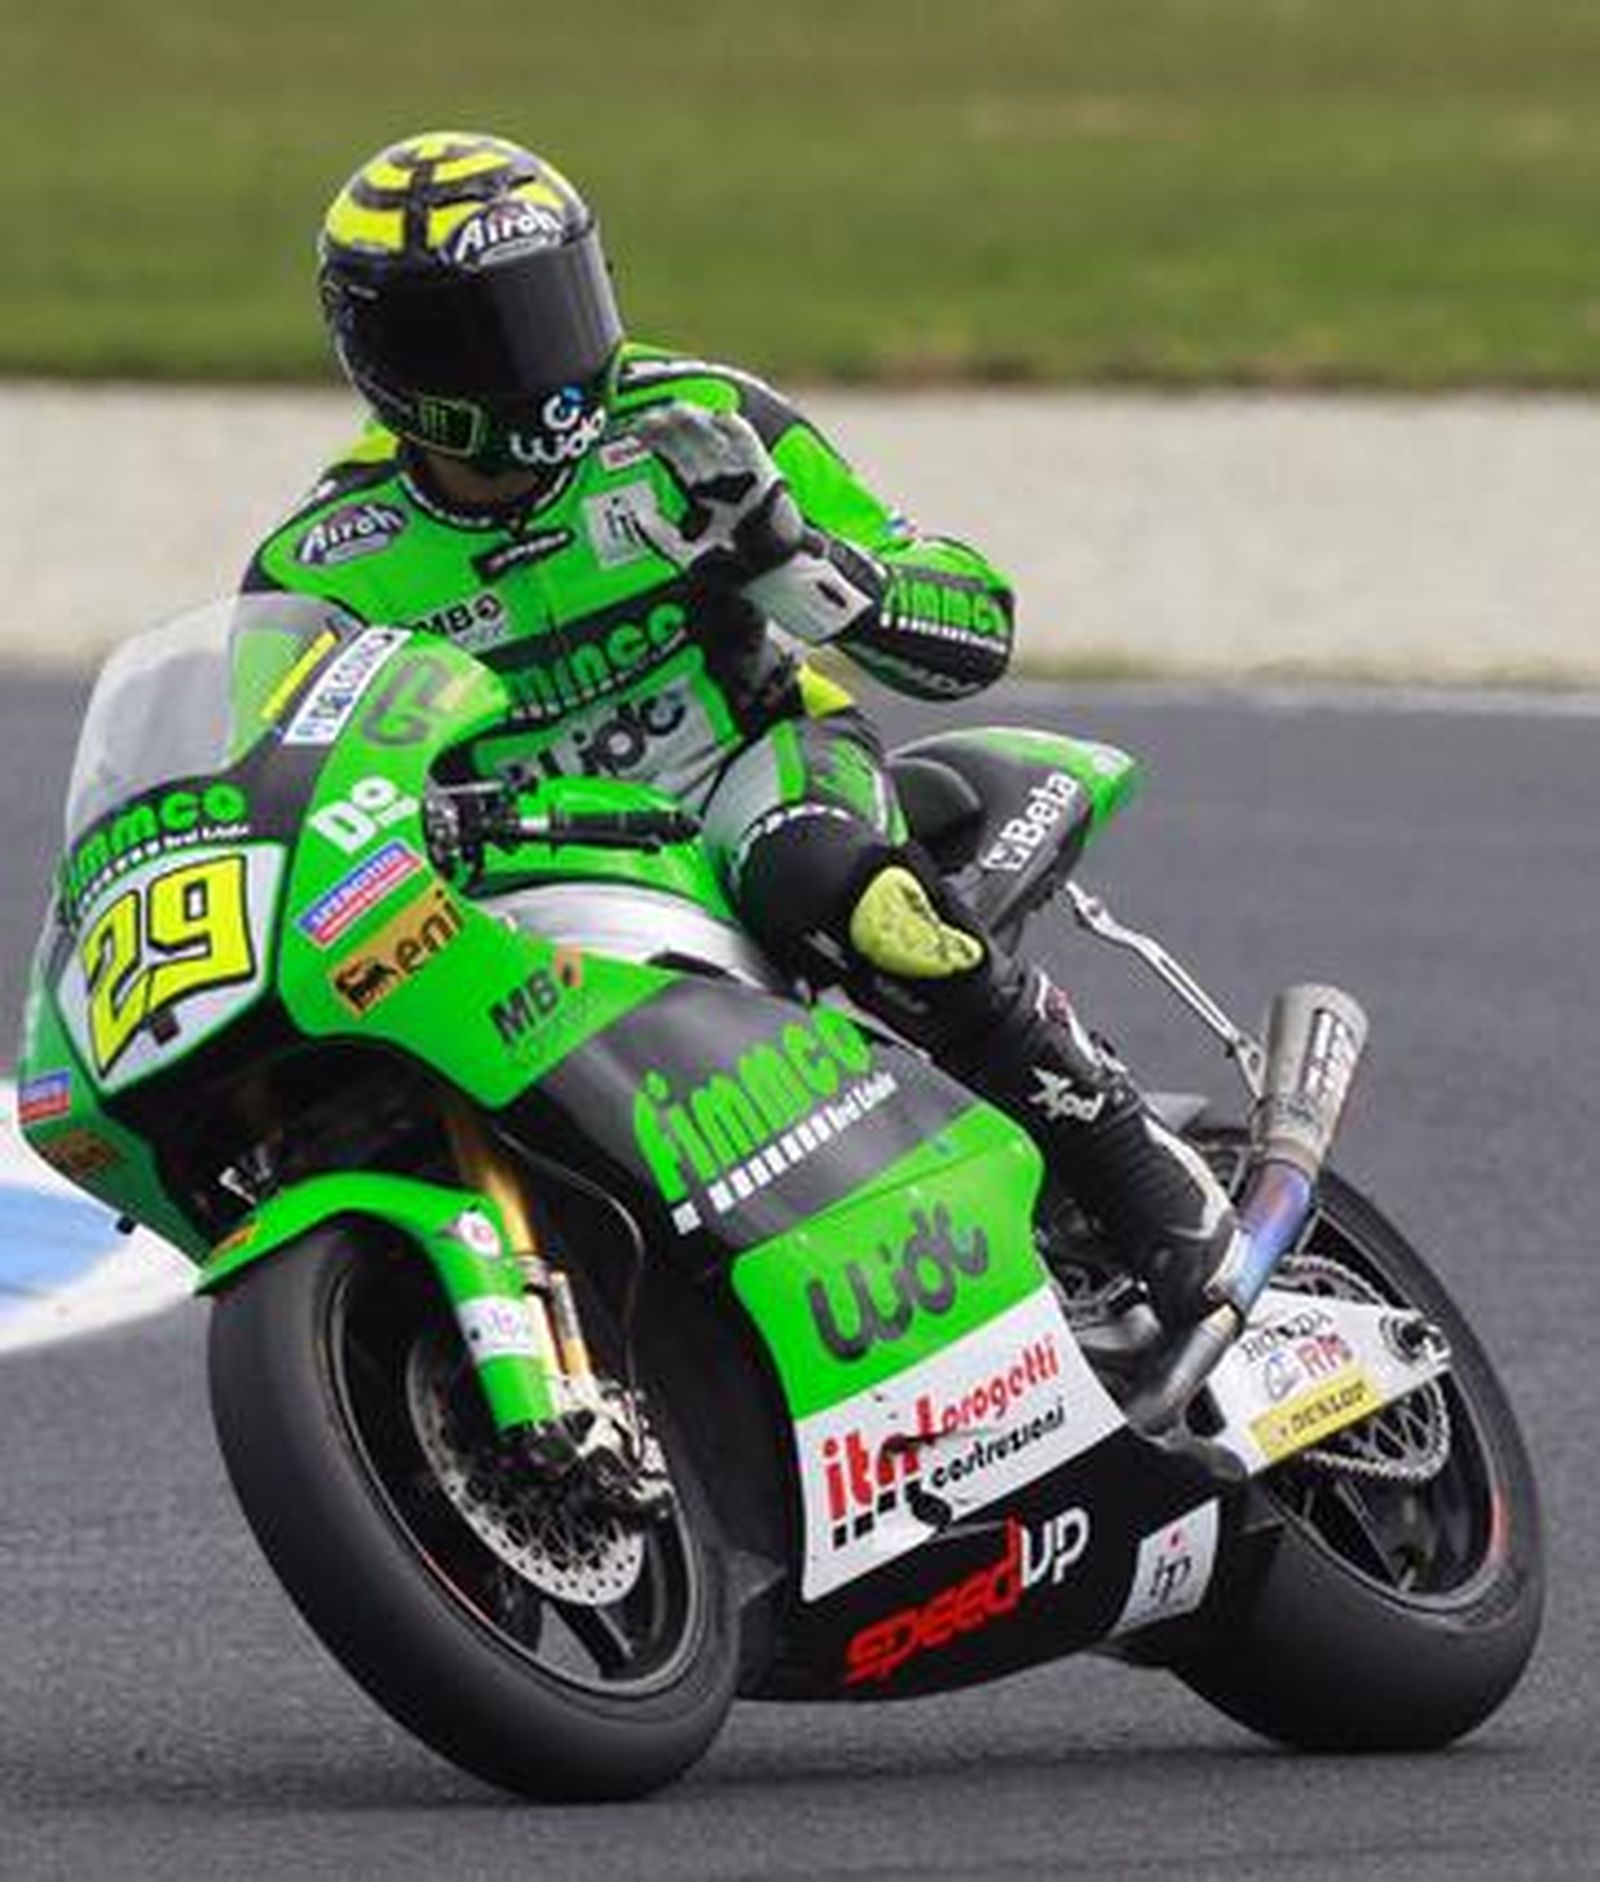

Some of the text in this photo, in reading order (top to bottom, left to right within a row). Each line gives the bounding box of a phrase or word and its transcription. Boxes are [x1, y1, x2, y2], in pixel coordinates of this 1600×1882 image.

[301, 504, 403, 563] Airoh
[1000, 773, 1077, 848] Beta
[82, 854, 257, 1078] 29
